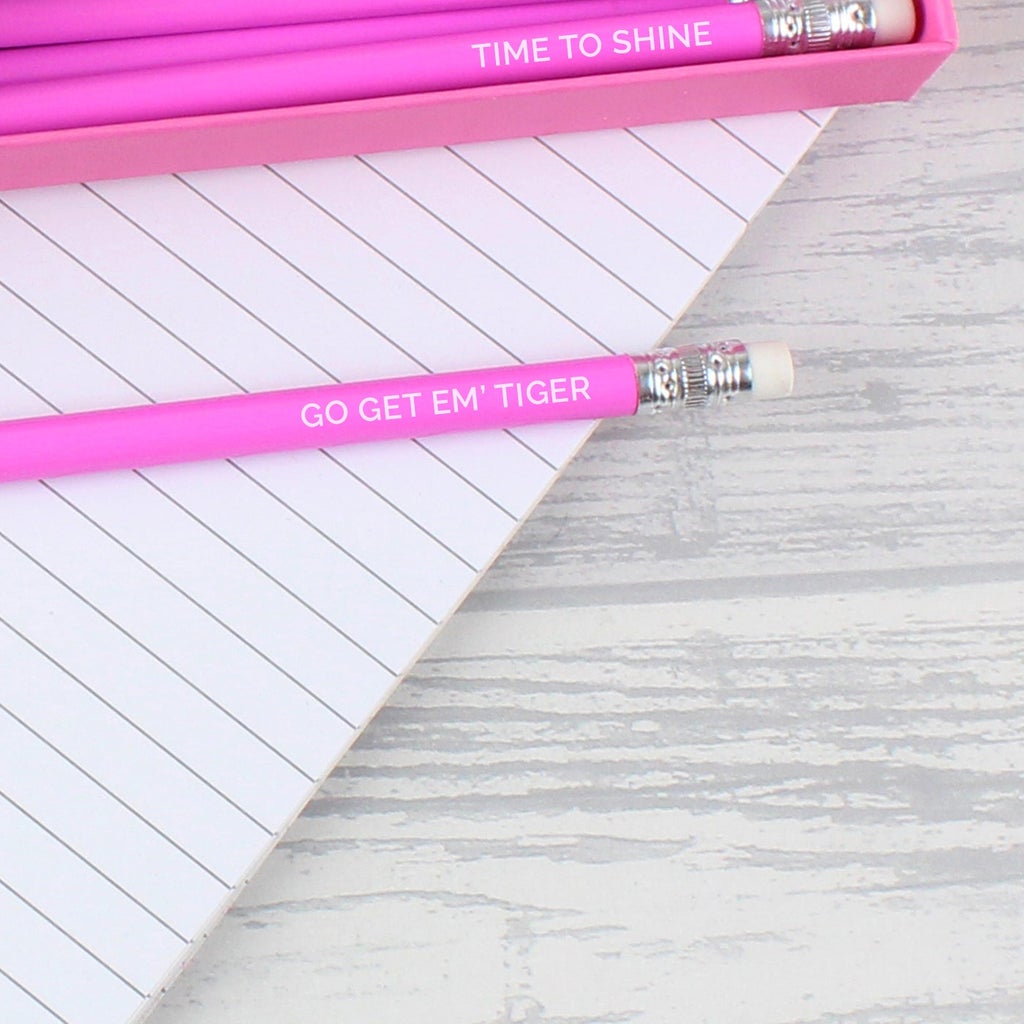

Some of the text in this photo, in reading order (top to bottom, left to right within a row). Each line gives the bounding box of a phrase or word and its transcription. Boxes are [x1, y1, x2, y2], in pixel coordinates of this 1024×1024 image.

[471, 21, 713, 69] TIME TO SHINE
[300, 399, 349, 428] GO
[358, 392, 422, 421] GET
[494, 375, 592, 408] TIGER
